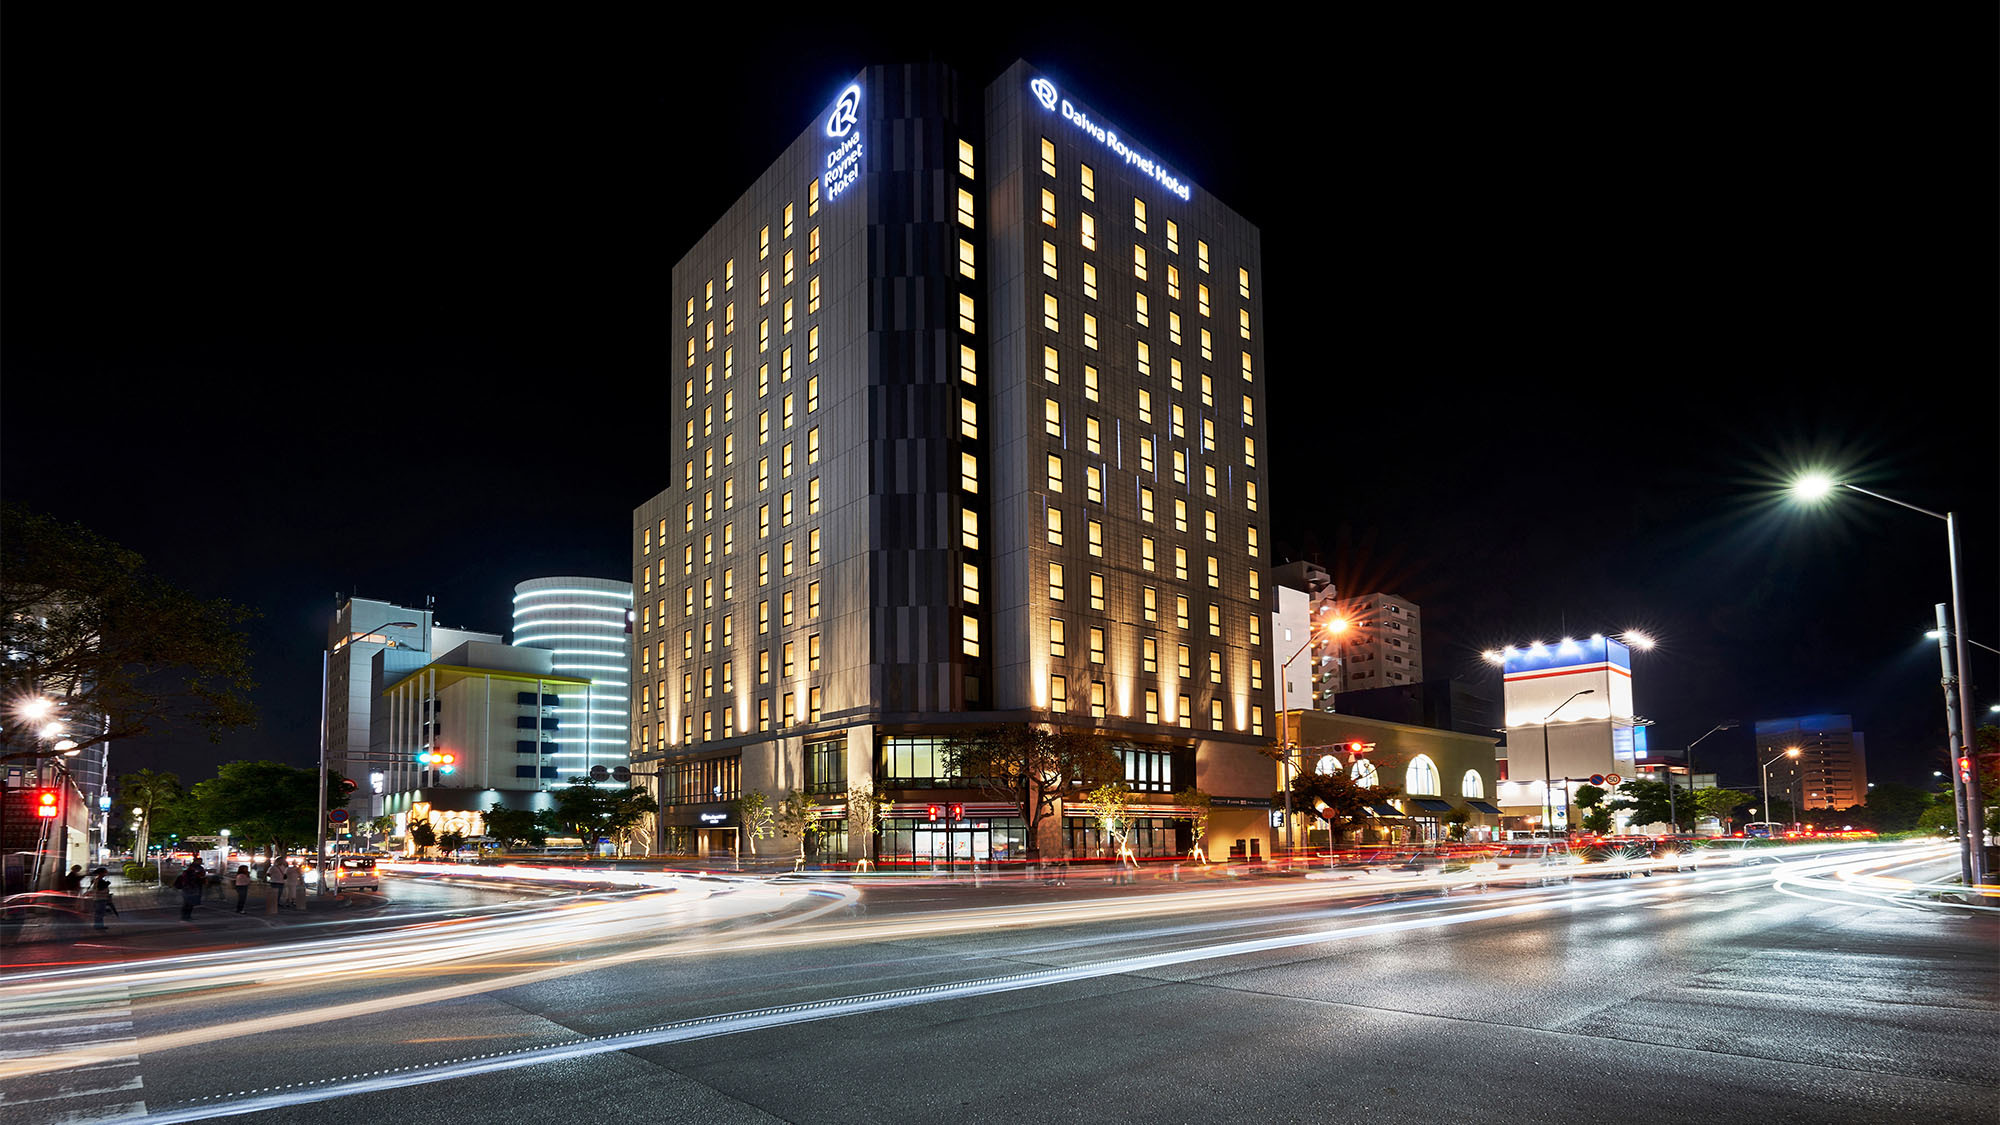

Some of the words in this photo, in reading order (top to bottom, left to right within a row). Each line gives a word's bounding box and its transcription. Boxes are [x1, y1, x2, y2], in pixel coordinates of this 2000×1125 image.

[824, 143, 863, 187] Roynet
[827, 131, 859, 168] Daiwa
[1062, 99, 1106, 142] Daiwa
[1107, 130, 1154, 177] Roynet
[1155, 165, 1189, 200] Hotel
[828, 163, 859, 201] Hotel
